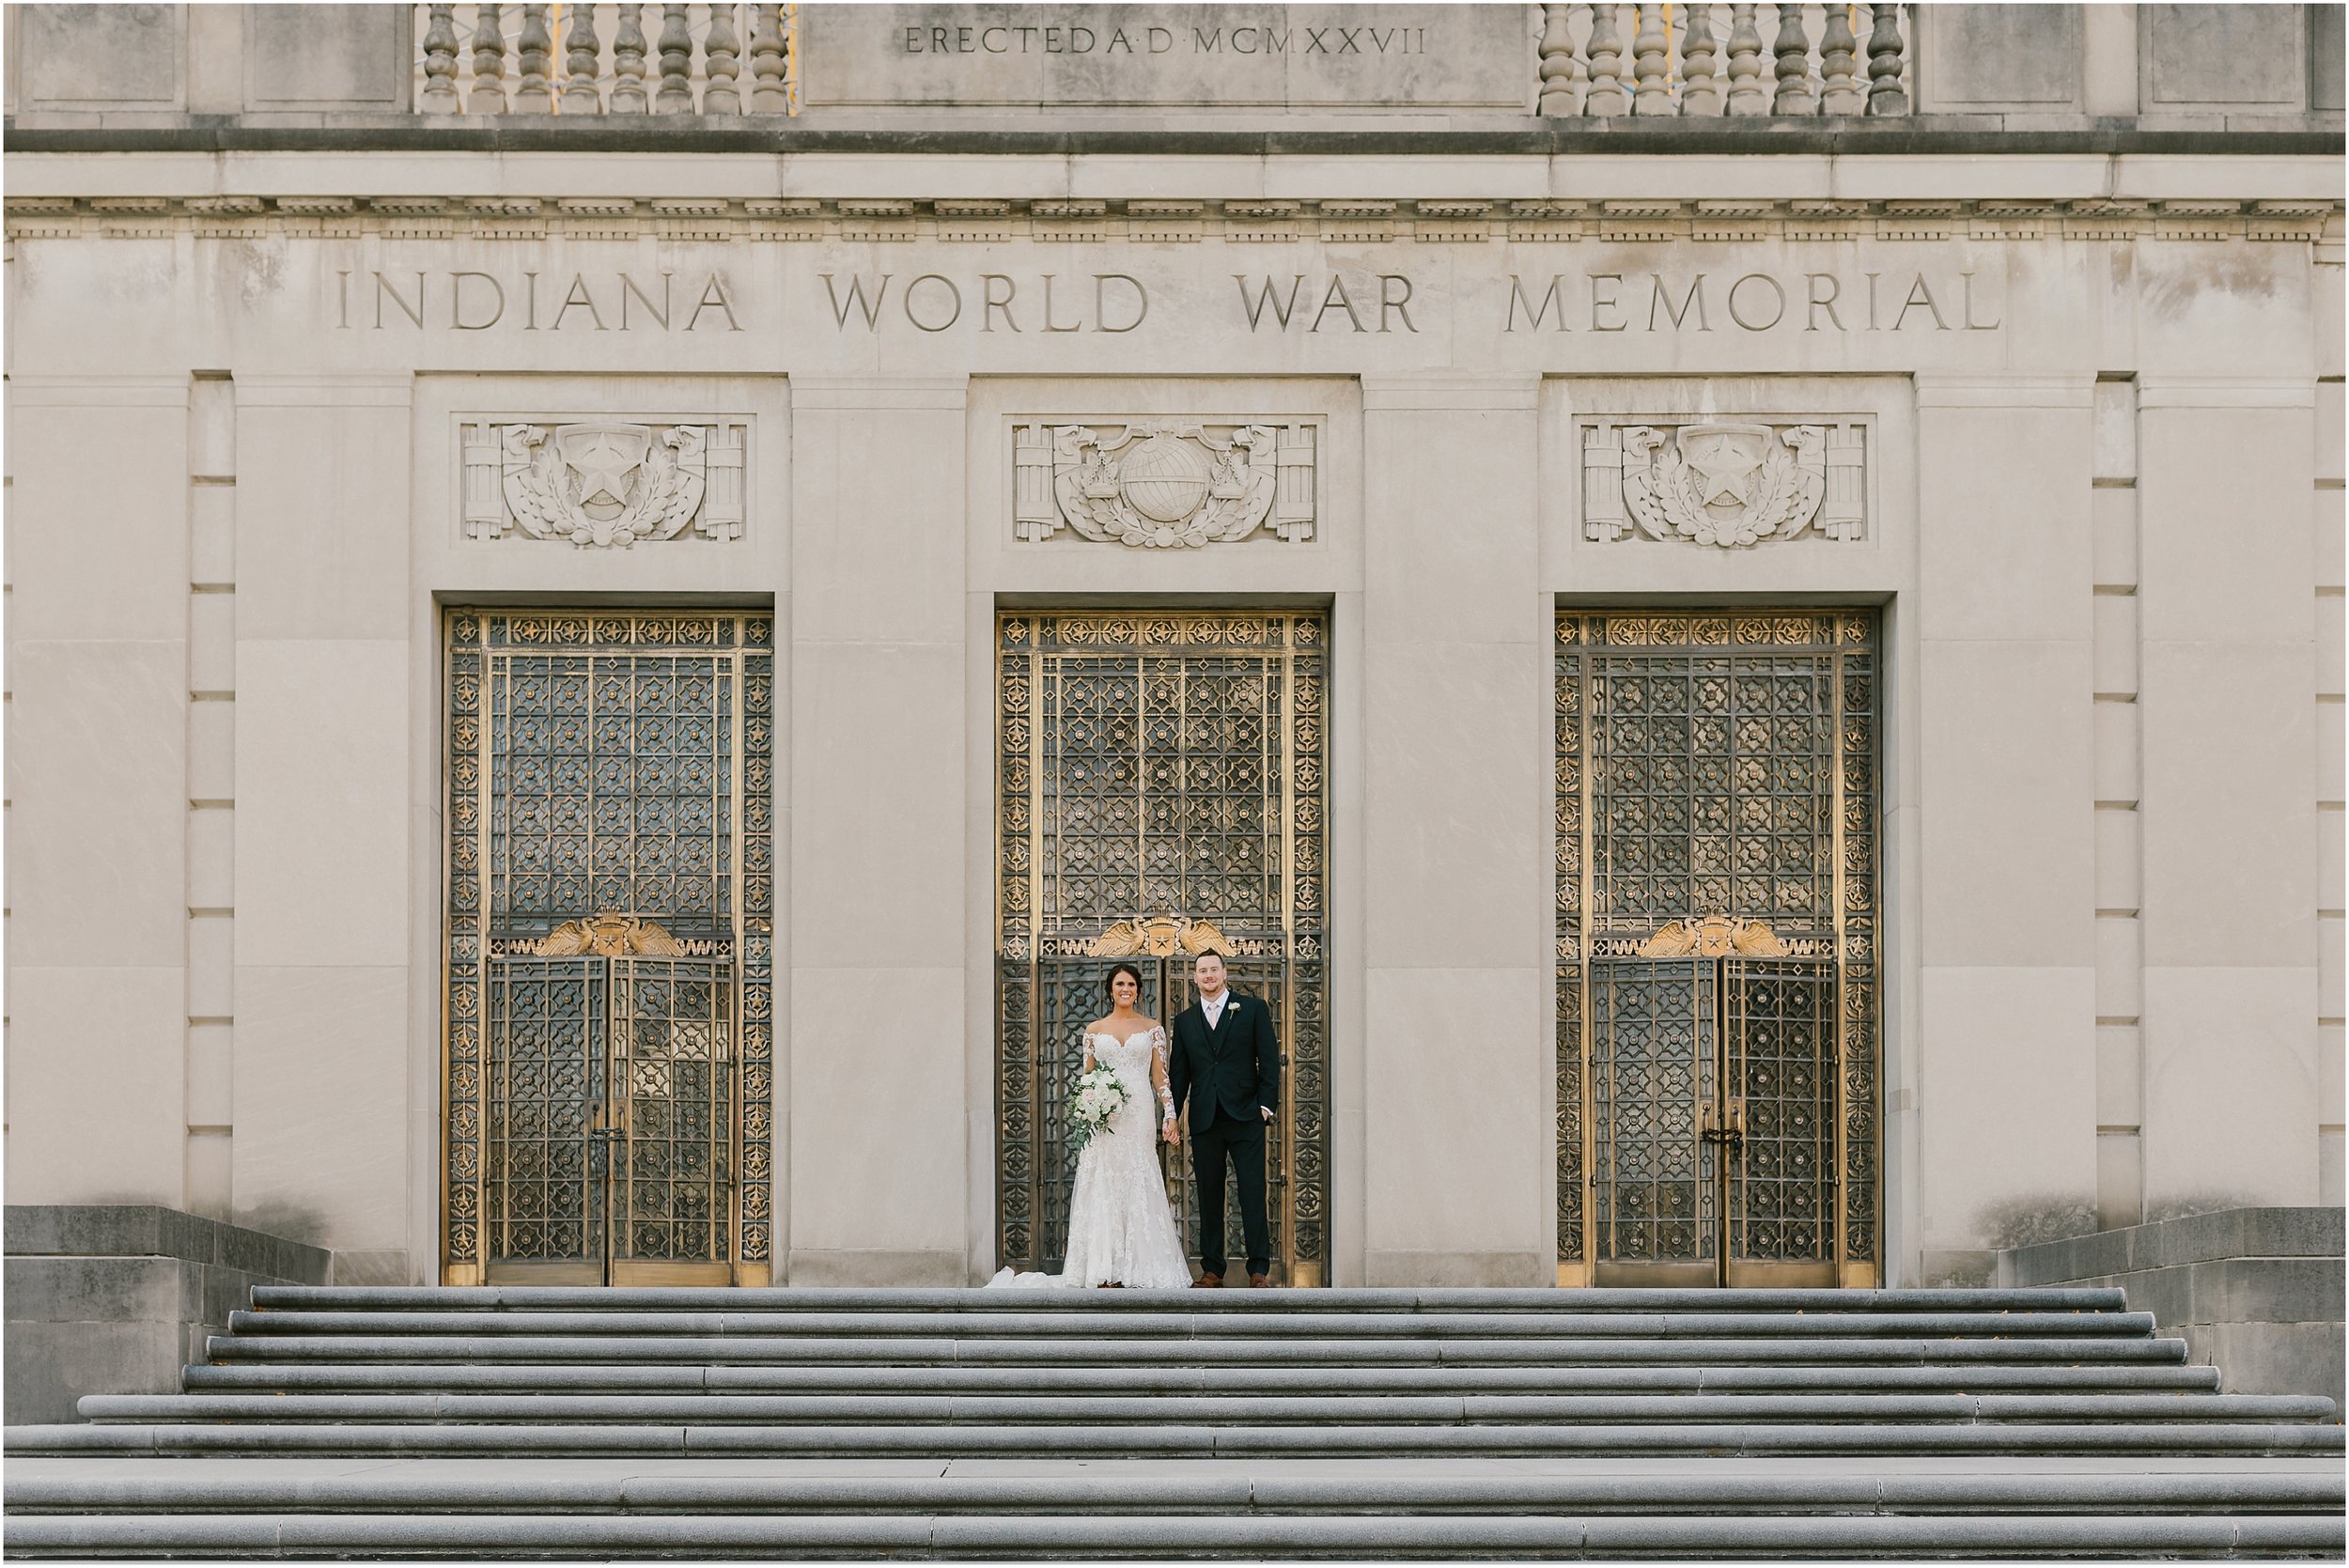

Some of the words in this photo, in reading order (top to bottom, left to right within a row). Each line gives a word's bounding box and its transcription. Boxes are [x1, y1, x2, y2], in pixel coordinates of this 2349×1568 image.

[905, 27, 1096, 54] ERECTED
[1193, 27, 1425, 54] MCMXXVII
[335, 270, 745, 332] INDIANA
[817, 273, 1148, 333] WORLD
[1230, 273, 1420, 333] WAR
[1502, 272, 2001, 333] MEMORIAL
